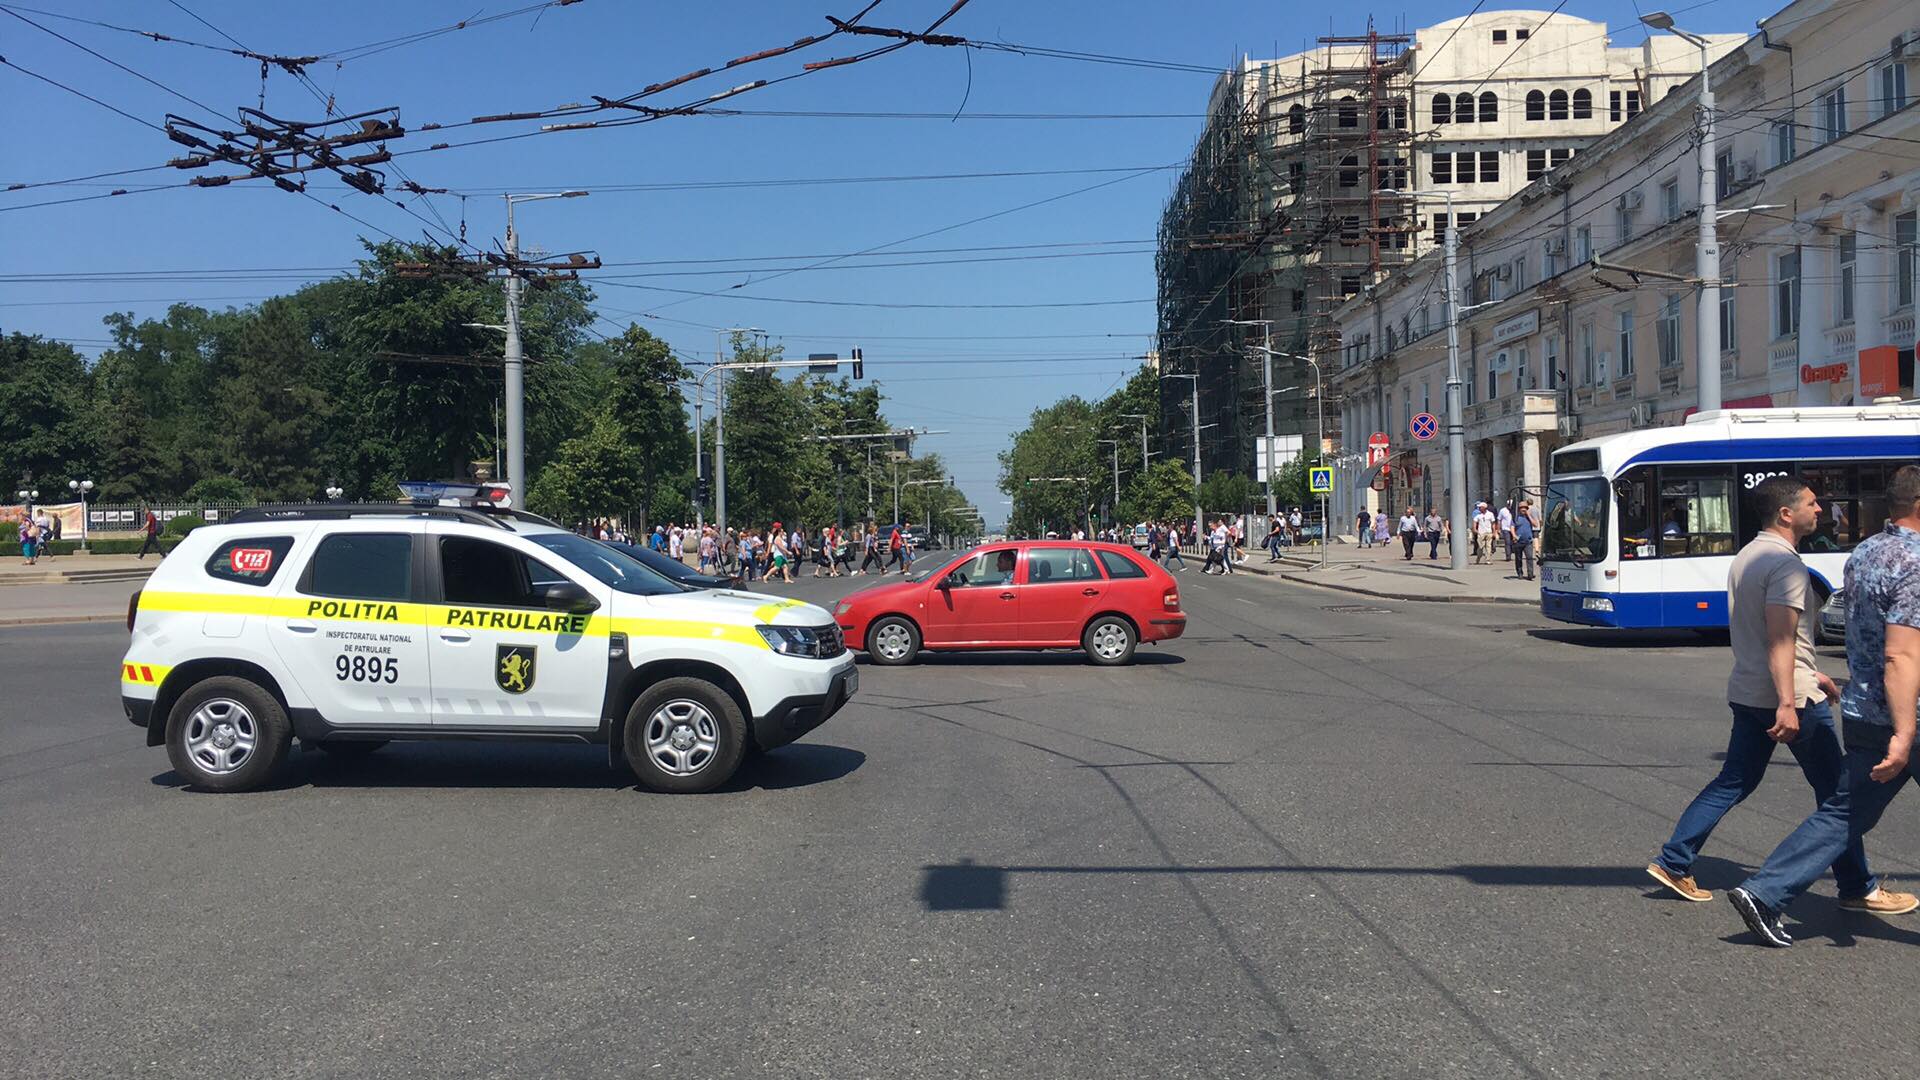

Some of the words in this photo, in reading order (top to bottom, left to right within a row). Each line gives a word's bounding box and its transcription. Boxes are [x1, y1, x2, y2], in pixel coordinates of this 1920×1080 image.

[1801, 363, 1848, 384] Orange
[1743, 471, 1788, 489] 38
[244, 553, 265, 567] 112
[447, 609, 585, 633] PATRULARE
[326, 630, 378, 641] INSPECTORATUL
[344, 644, 353, 652] DE
[354, 645, 391, 655] PATRULARE
[336, 654, 399, 684] 9895
